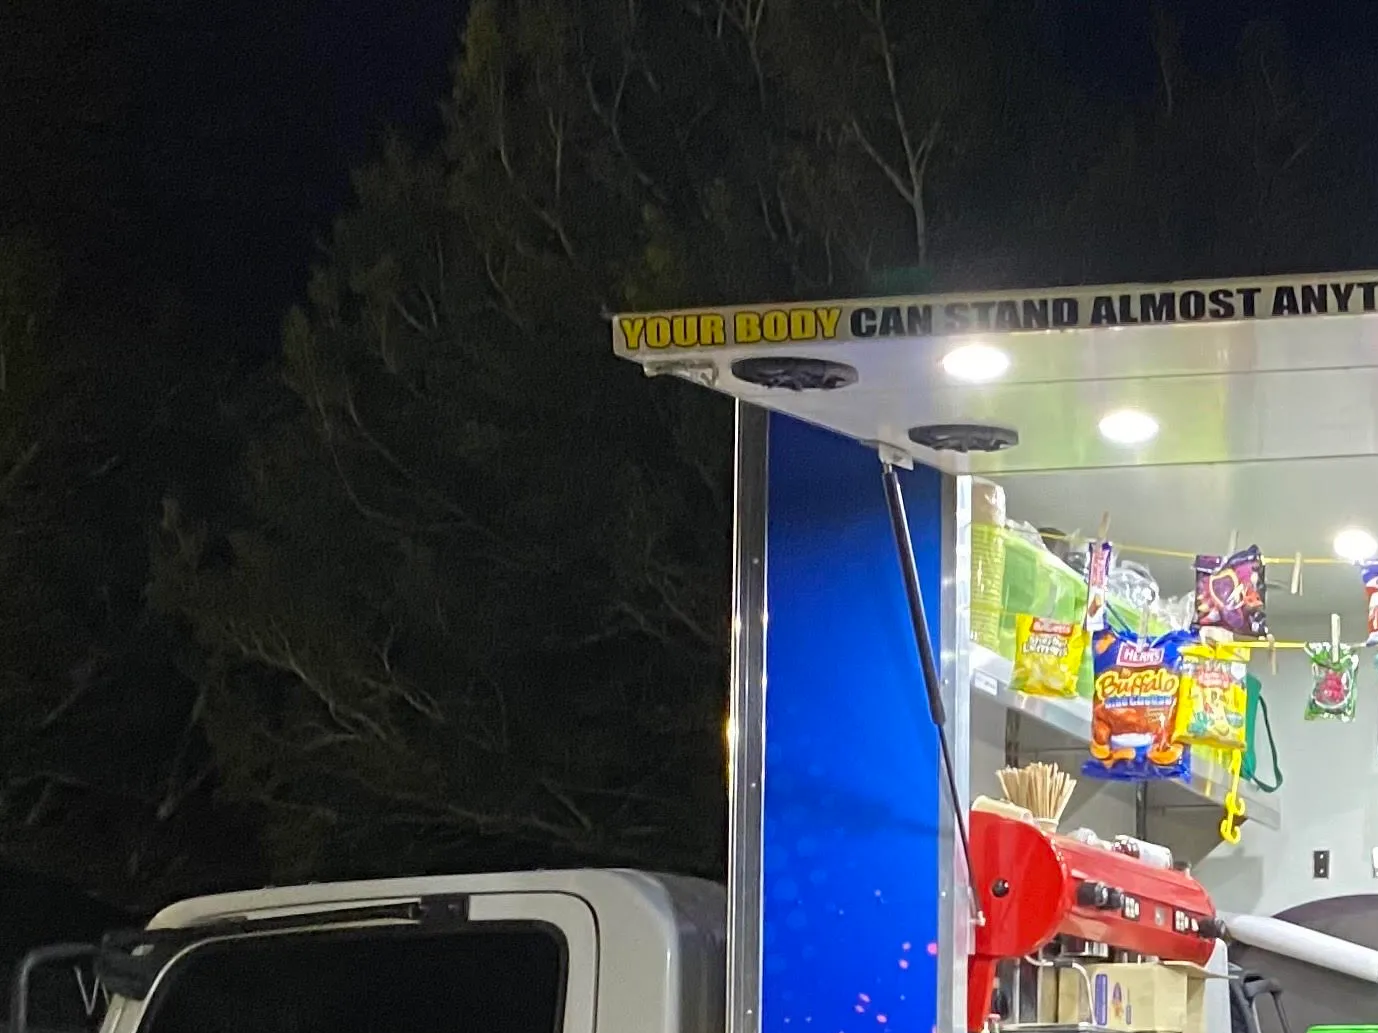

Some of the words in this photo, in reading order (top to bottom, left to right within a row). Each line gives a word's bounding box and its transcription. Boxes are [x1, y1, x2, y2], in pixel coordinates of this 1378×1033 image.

[619, 314, 726, 348] YOUR
[734, 308, 841, 344] BODY
[850, 306, 932, 337] CAN
[944, 297, 1079, 332] STAND
[1090, 288, 1261, 325] ALMOST
[1098, 669, 1178, 697] Buffalo
